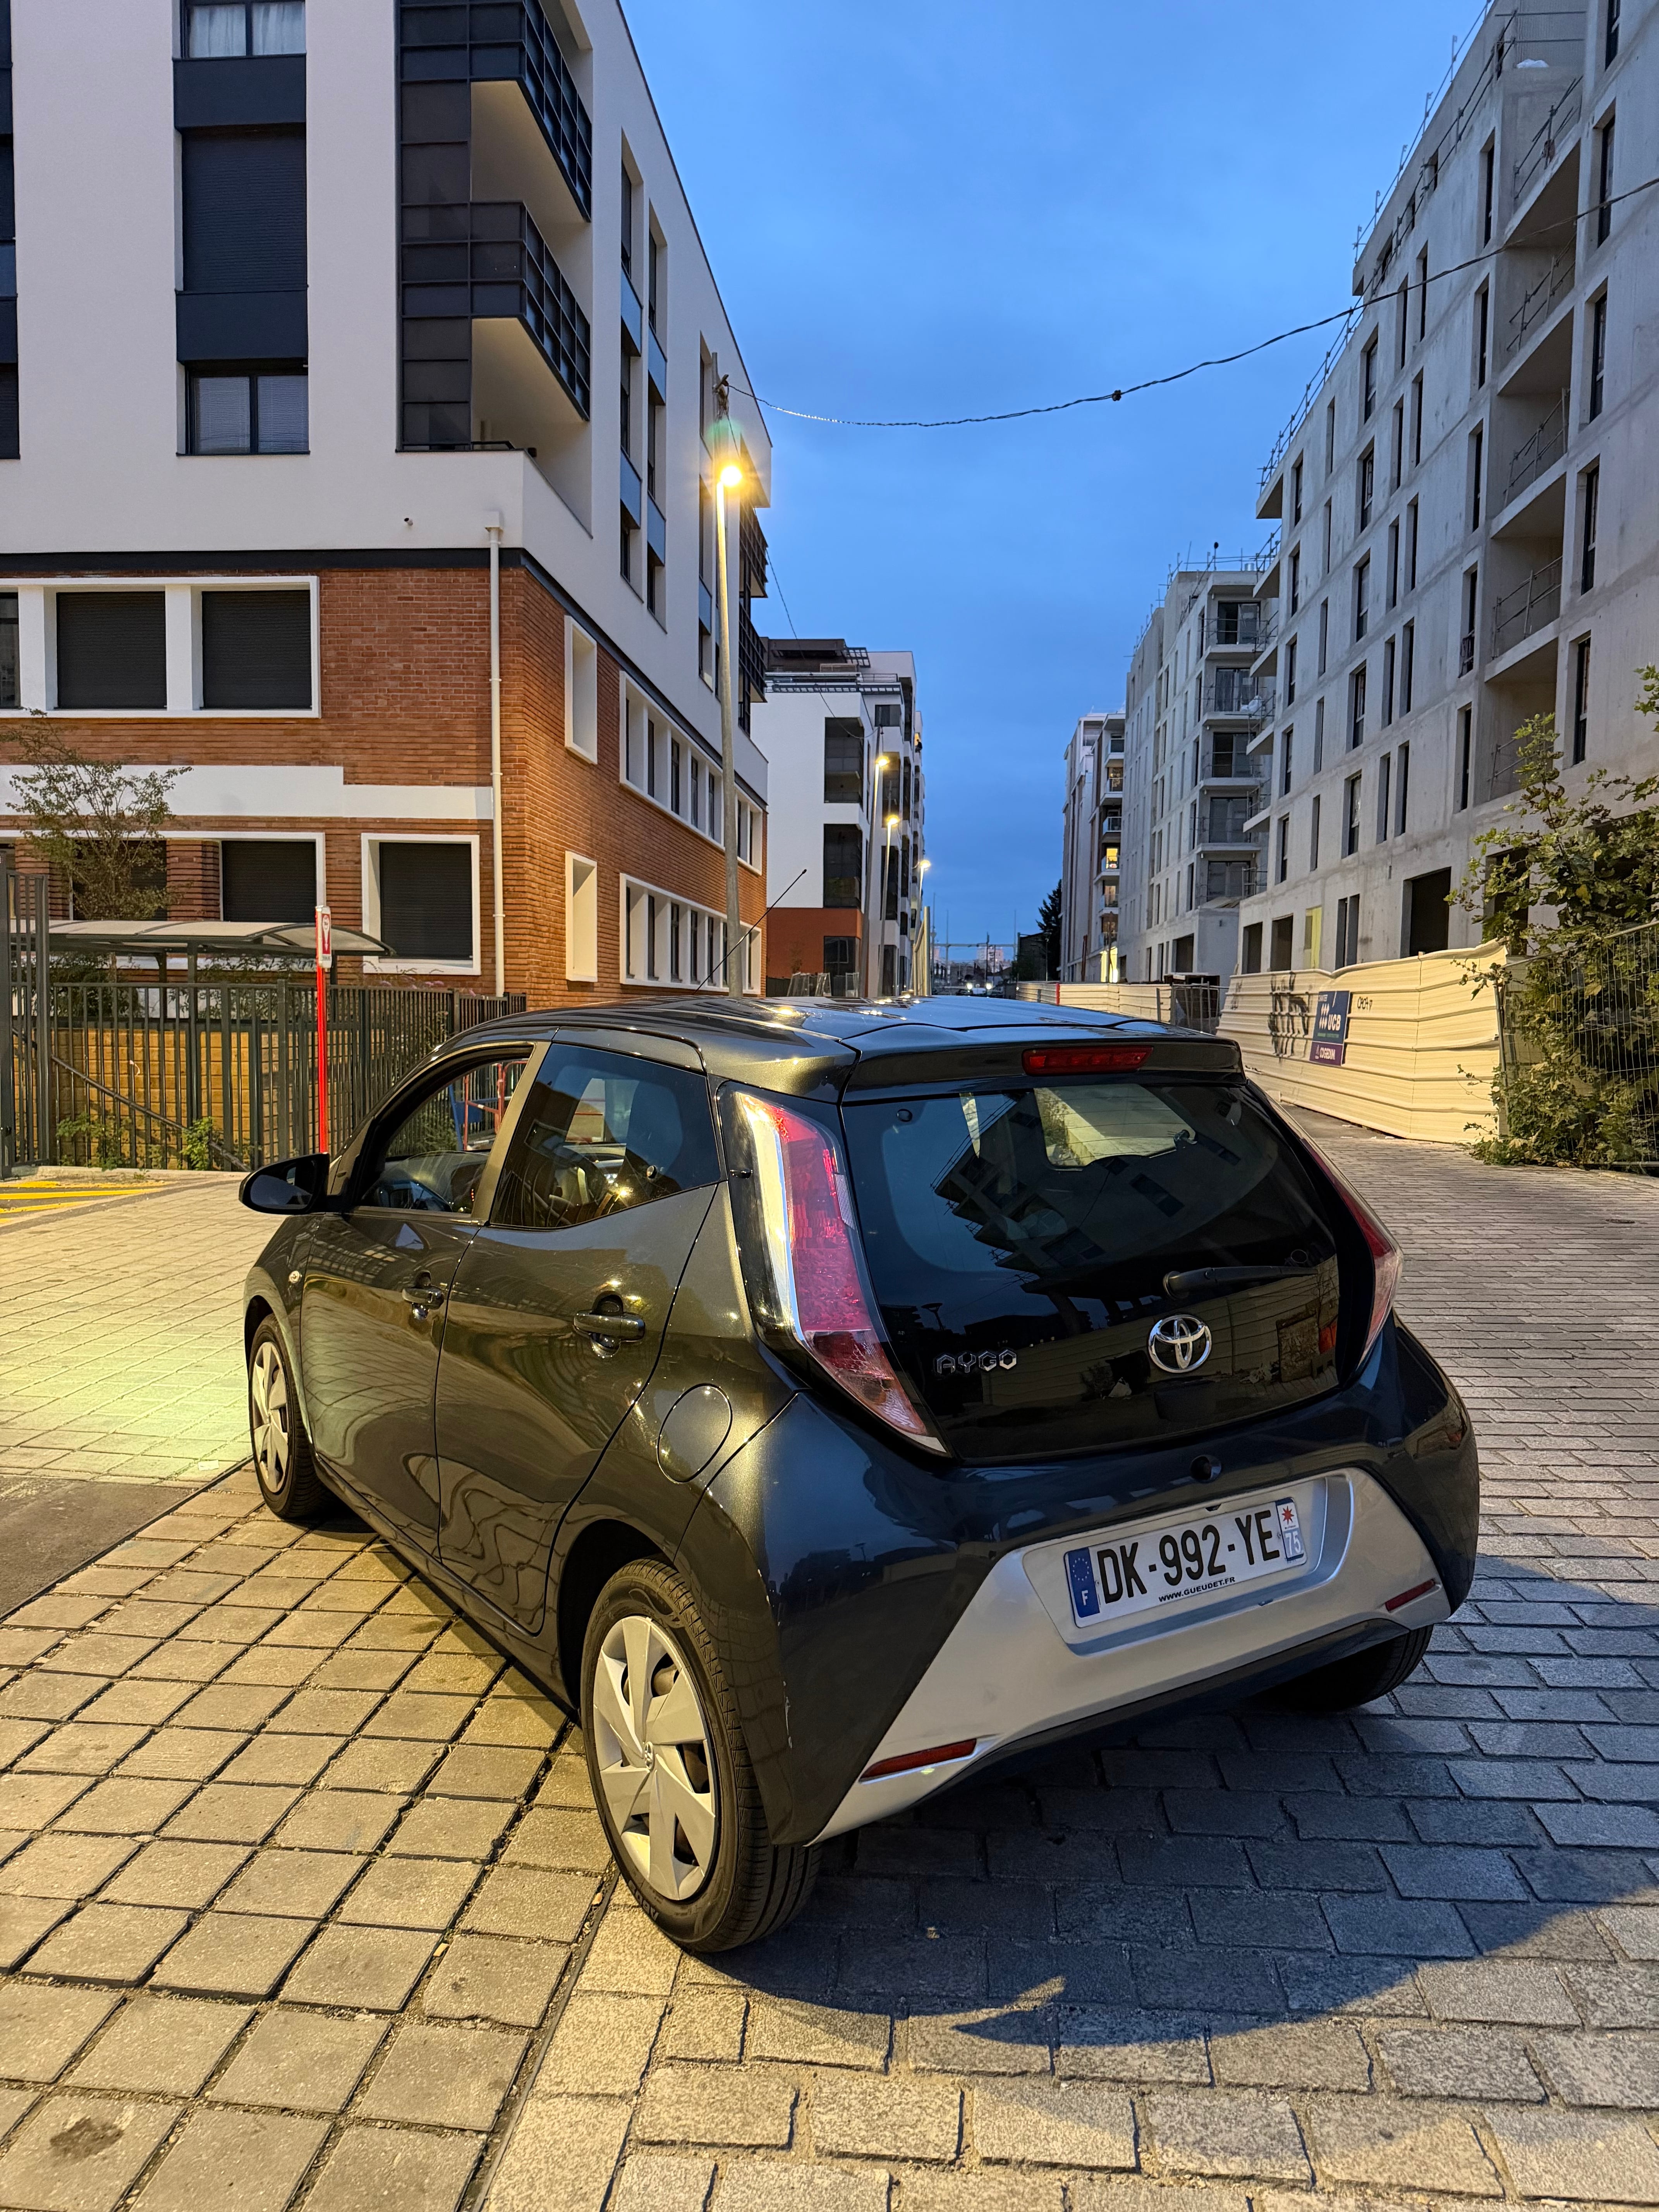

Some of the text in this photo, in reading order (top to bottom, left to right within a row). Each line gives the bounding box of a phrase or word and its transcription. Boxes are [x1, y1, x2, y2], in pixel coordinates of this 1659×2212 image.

[1328, 1014, 1341, 1031] UCB
[937, 1350, 1017, 1374] AYGO
[1285, 1531, 1301, 1556] 75
[1097, 1510, 1280, 1604] DK-992-YE
[1082, 1590, 1088, 1606] F
[1158, 1576, 1236, 1602] WWW.GUEUDET.FR
